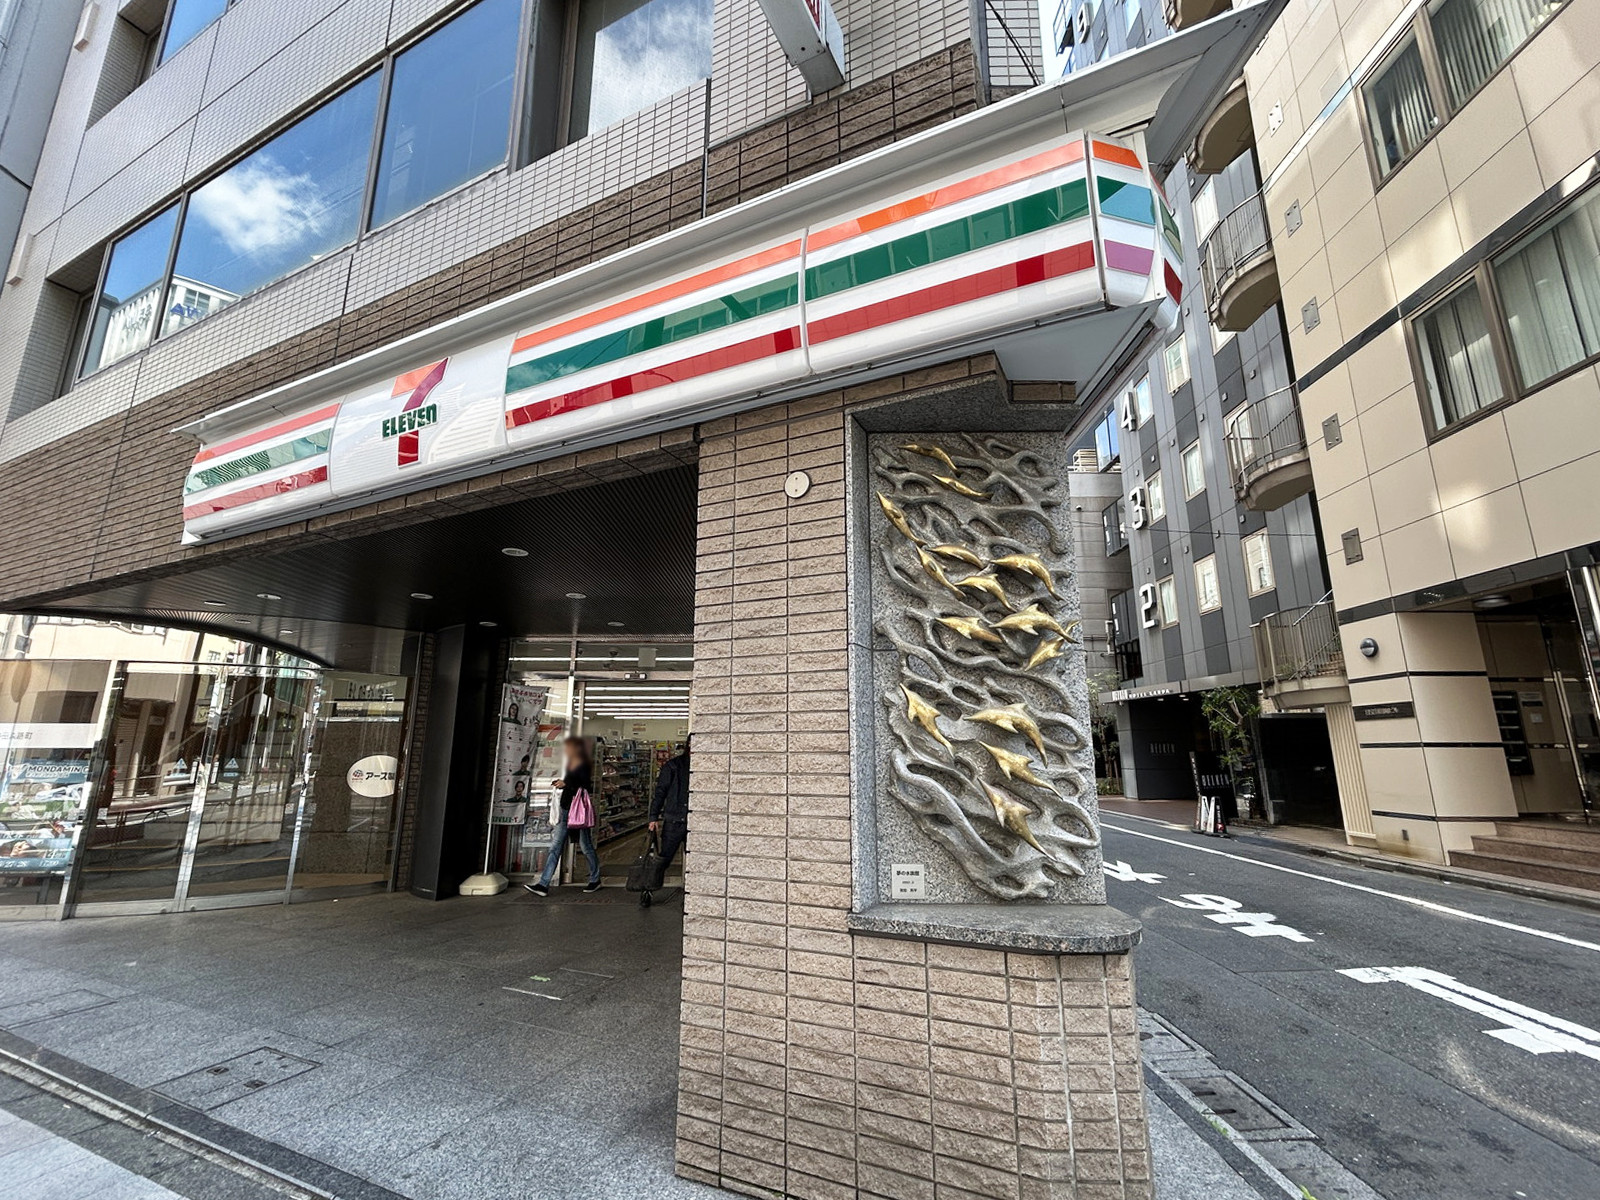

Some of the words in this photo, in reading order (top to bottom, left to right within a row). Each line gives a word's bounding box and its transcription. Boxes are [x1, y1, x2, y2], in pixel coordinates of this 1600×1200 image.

[1121, 391, 1135, 433] 4
[1129, 486, 1147, 531] 3
[1139, 583, 1158, 629] 2
[28, 765, 80, 773] MONDAMIN
